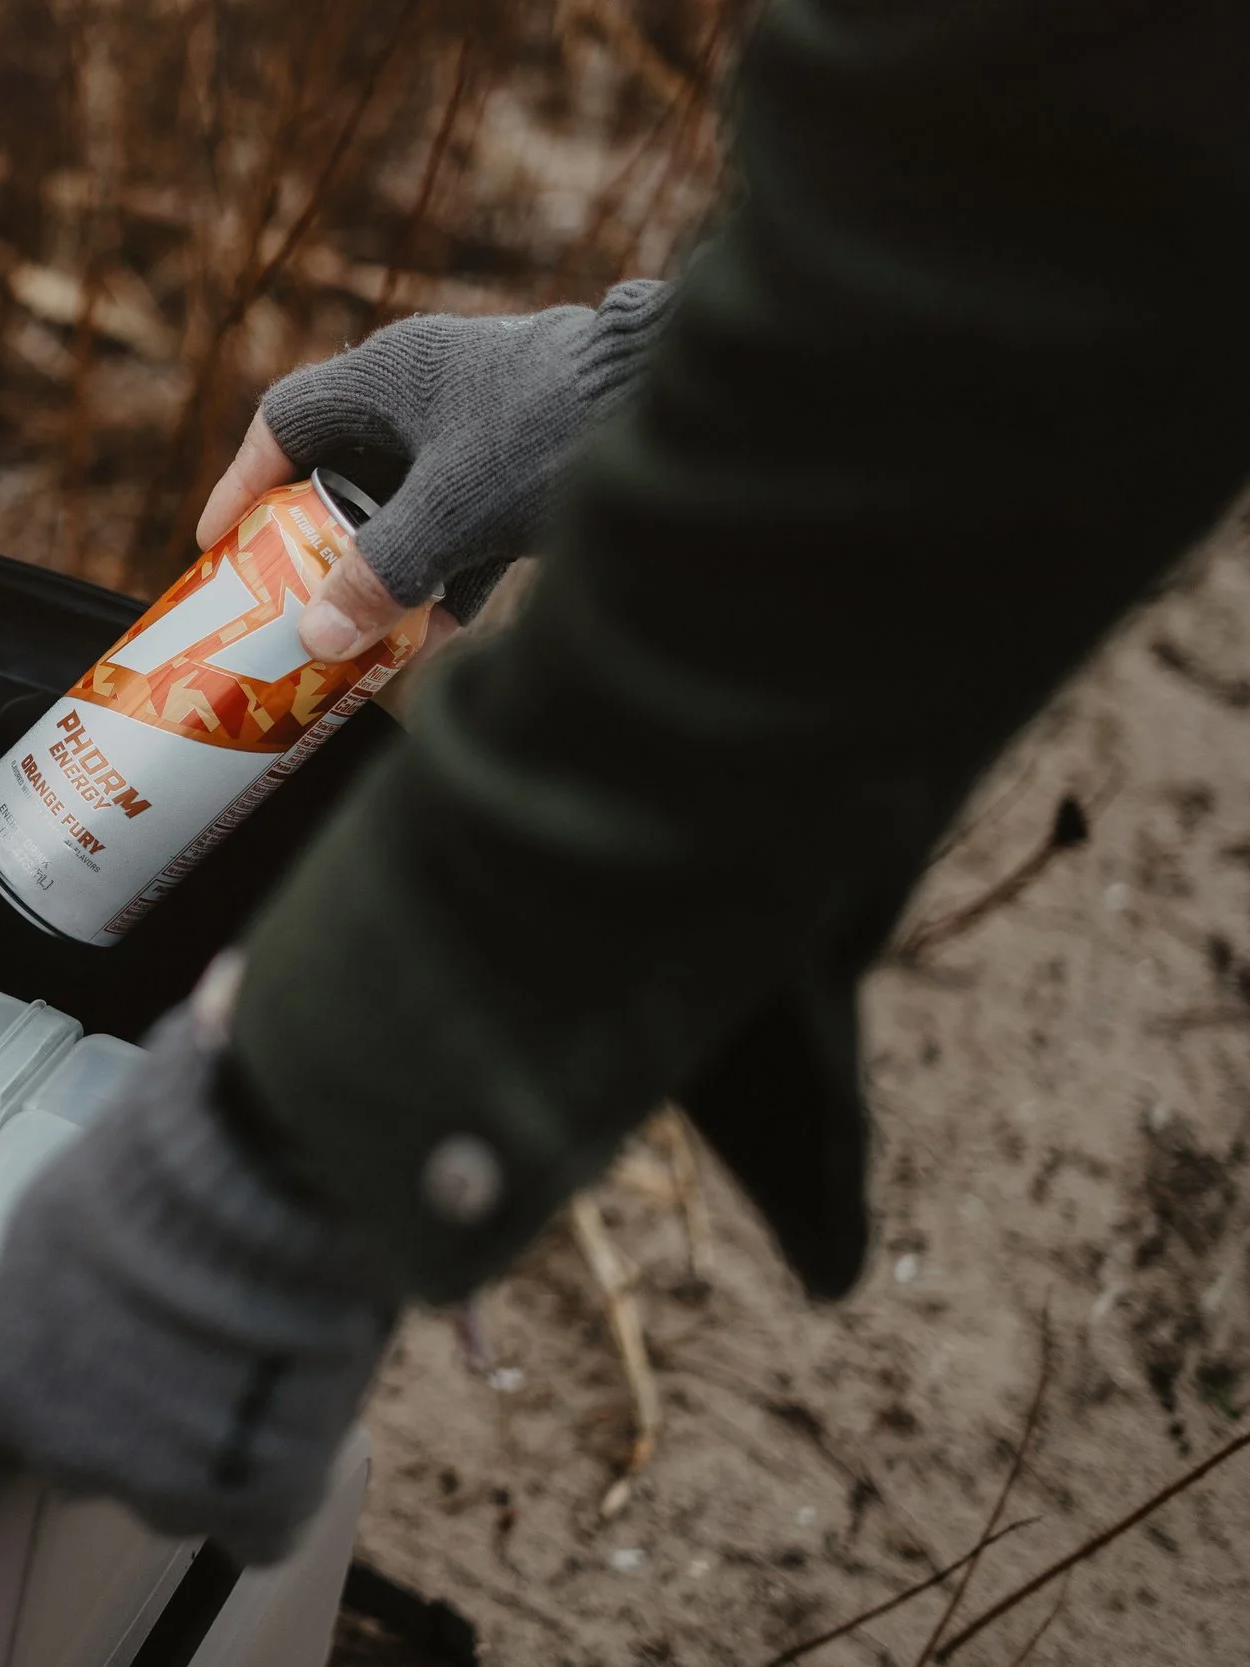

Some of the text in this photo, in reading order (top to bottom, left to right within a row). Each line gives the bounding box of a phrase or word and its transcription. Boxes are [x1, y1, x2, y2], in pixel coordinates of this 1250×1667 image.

[287, 506, 323, 550] NATURAL
[48, 740, 114, 812] ENERGY
[56, 709, 153, 819] PHORM
[20, 753, 65, 817] ORANGE
[61, 812, 106, 855] FURY
[73, 847, 101, 874] FLAVORS
